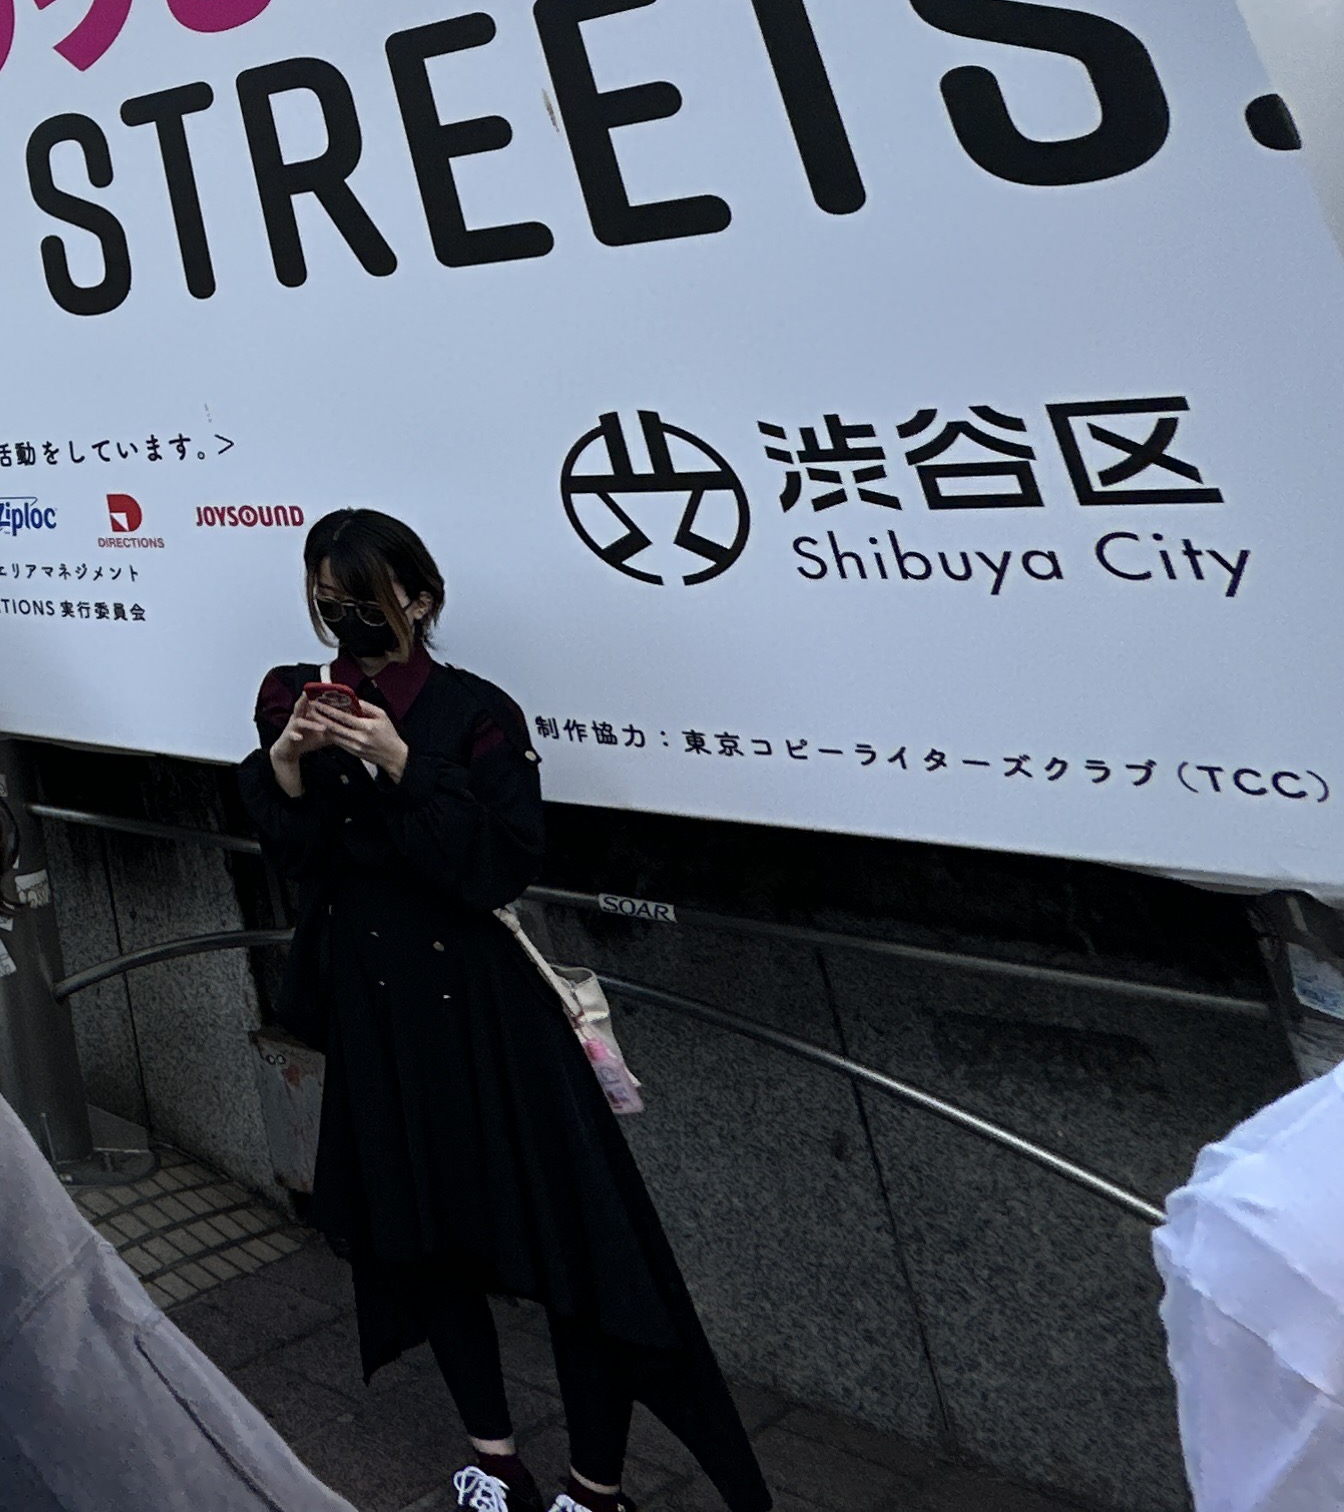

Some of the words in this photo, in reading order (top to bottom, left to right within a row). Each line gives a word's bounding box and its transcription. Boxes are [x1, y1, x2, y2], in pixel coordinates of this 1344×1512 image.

[757, 395, 1226, 513] 渋谷区
[196, 505, 305, 527] JOYSOUND
[98, 537, 165, 549] DIRECTIONS
[793, 530, 1065, 596] Shibuya
[1093, 530, 1252, 598] City
[60, 600, 146, 622] 実行委員会
[602, 896, 673, 924] SOAR
